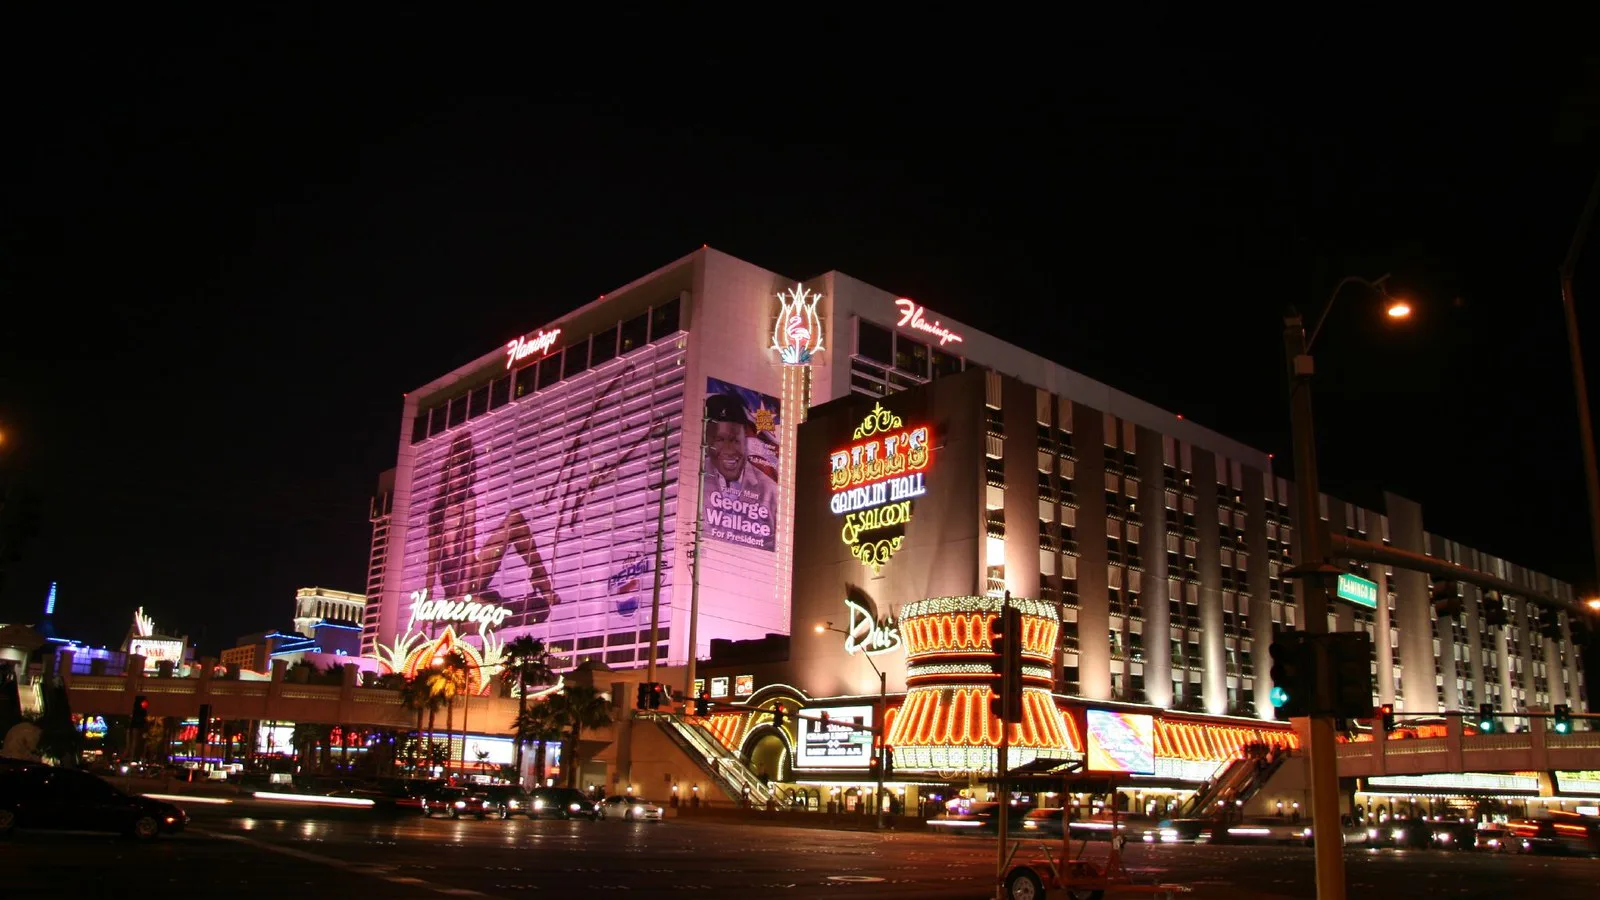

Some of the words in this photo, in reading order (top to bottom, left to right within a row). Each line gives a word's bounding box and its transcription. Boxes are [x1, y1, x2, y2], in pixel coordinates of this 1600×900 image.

[895, 298, 963, 345] Flamingo
[506, 328, 561, 370] Flamingo
[830, 427, 929, 490] BILL'S
[743, 490, 760, 500] Man
[890, 473, 926, 501] HALL
[710, 491, 769, 520] George
[706, 508, 771, 537] Wallace
[711, 528, 725, 539] For
[726, 531, 764, 547] President
[608, 557, 649, 592] PEPSI
[408, 588, 513, 635] Flamingo
